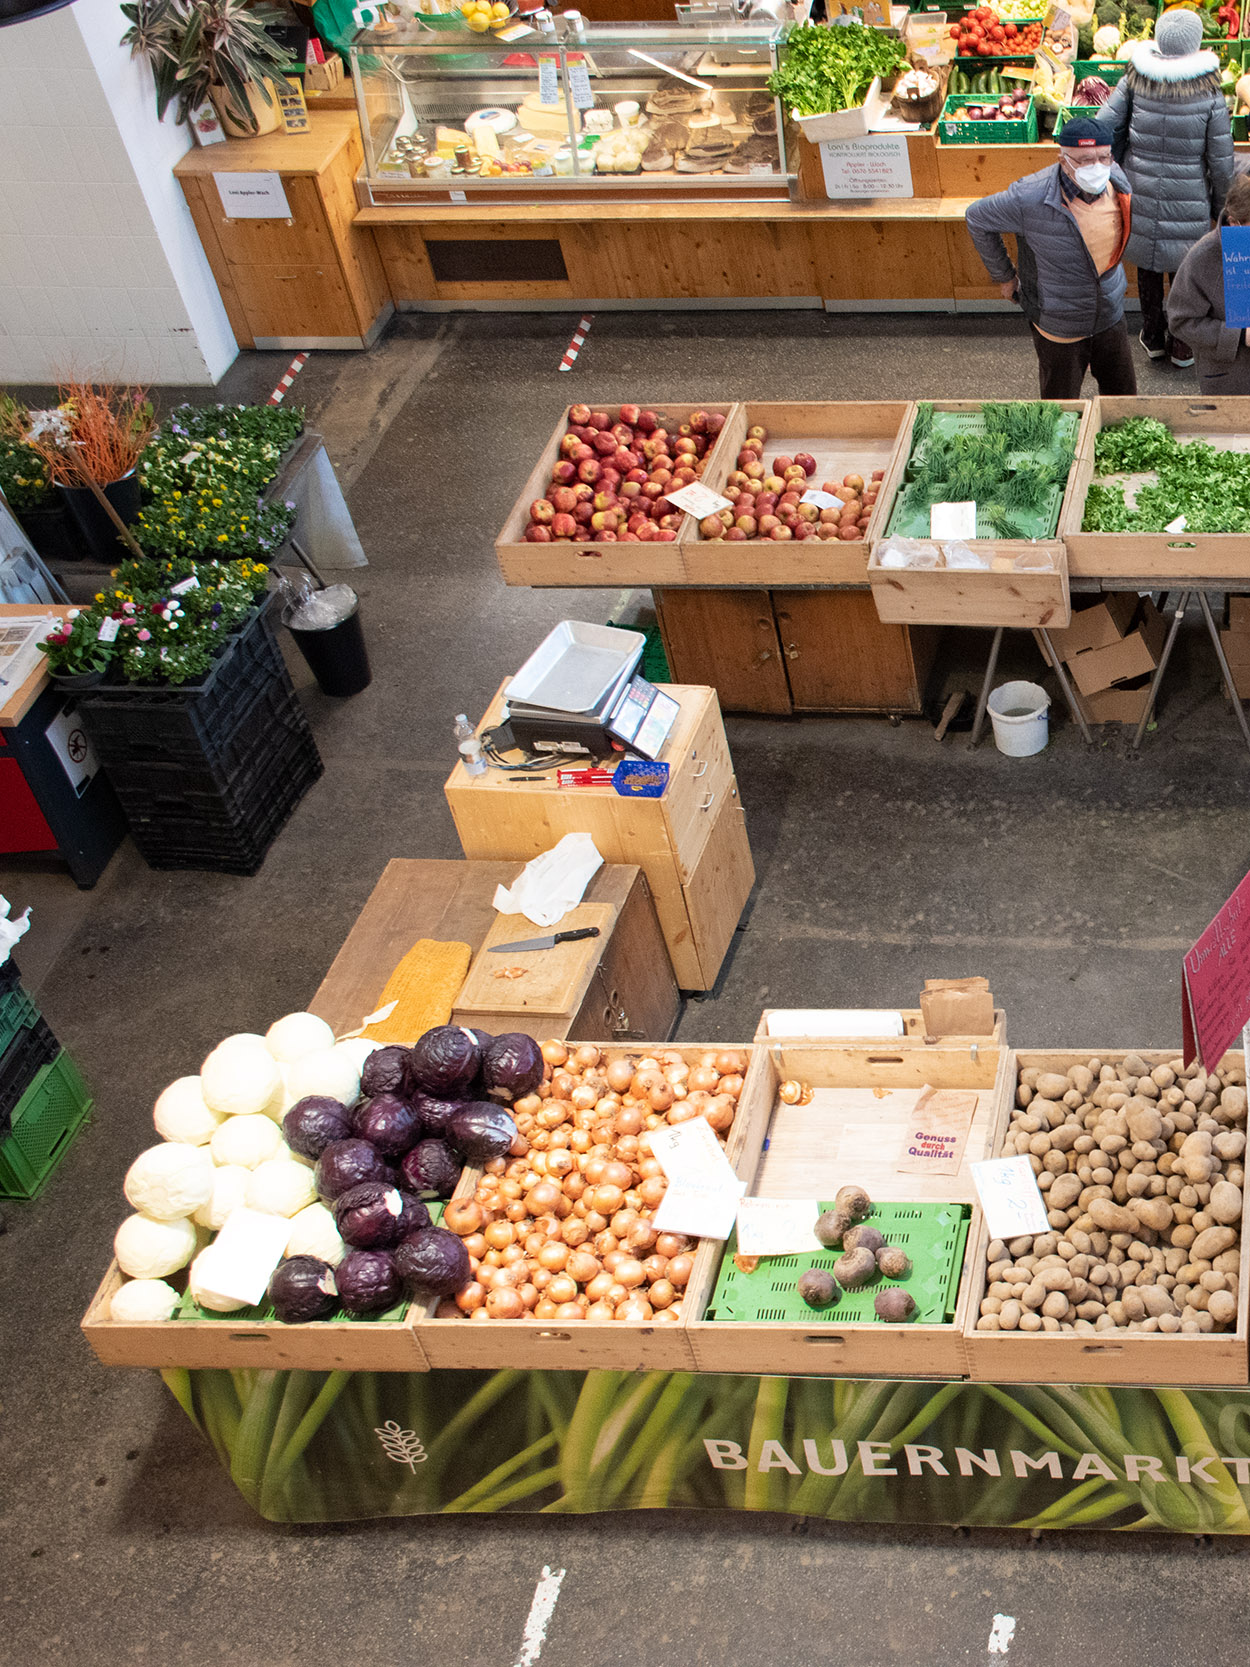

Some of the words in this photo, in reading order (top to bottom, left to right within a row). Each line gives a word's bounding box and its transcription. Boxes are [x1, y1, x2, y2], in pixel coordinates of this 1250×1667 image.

[852, 142, 900, 152] Bioprodukte
[1225, 266, 1236, 275] ist
[915, 1132, 957, 1143] Genuss
[921, 1141, 946, 1150] durch
[908, 1146, 954, 1158] Qualität
